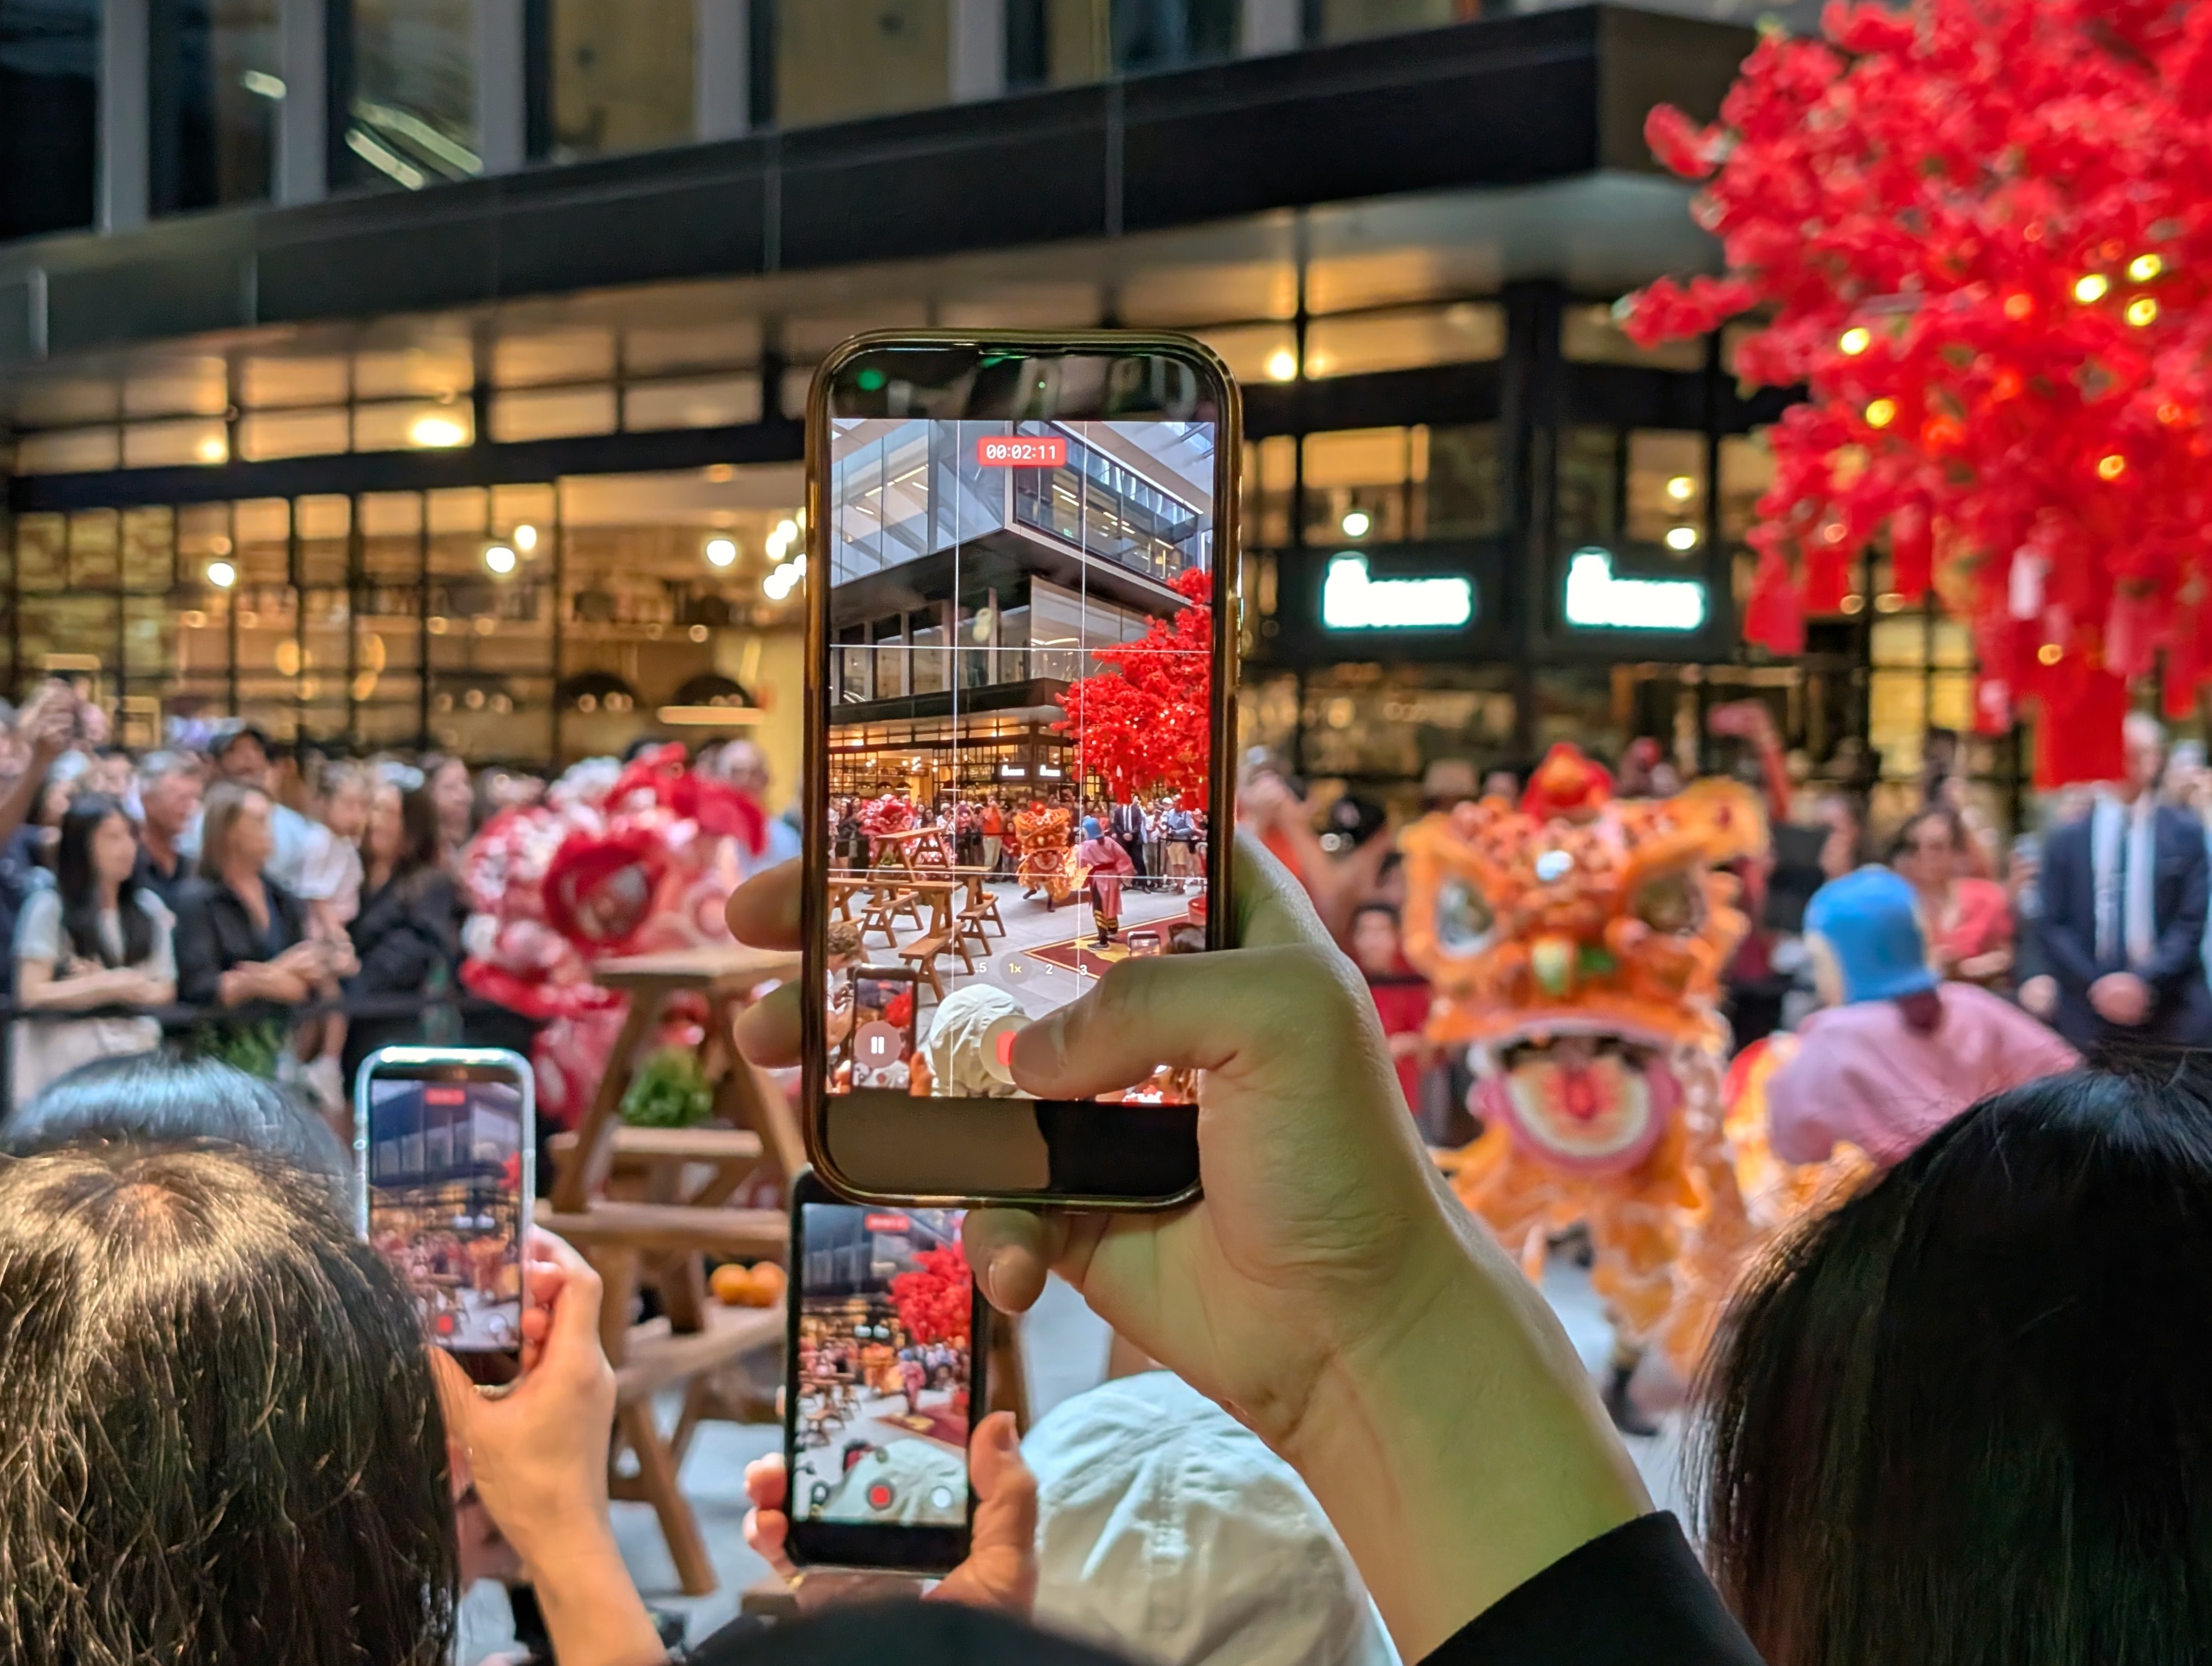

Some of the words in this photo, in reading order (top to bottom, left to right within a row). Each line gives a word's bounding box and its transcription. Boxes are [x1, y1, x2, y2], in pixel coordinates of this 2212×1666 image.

[986, 444, 1056, 459] 00:02:11
[1009, 963, 1022, 974] 1x
[1045, 964, 1053, 975] 2
[1080, 964, 1088, 975] 3
